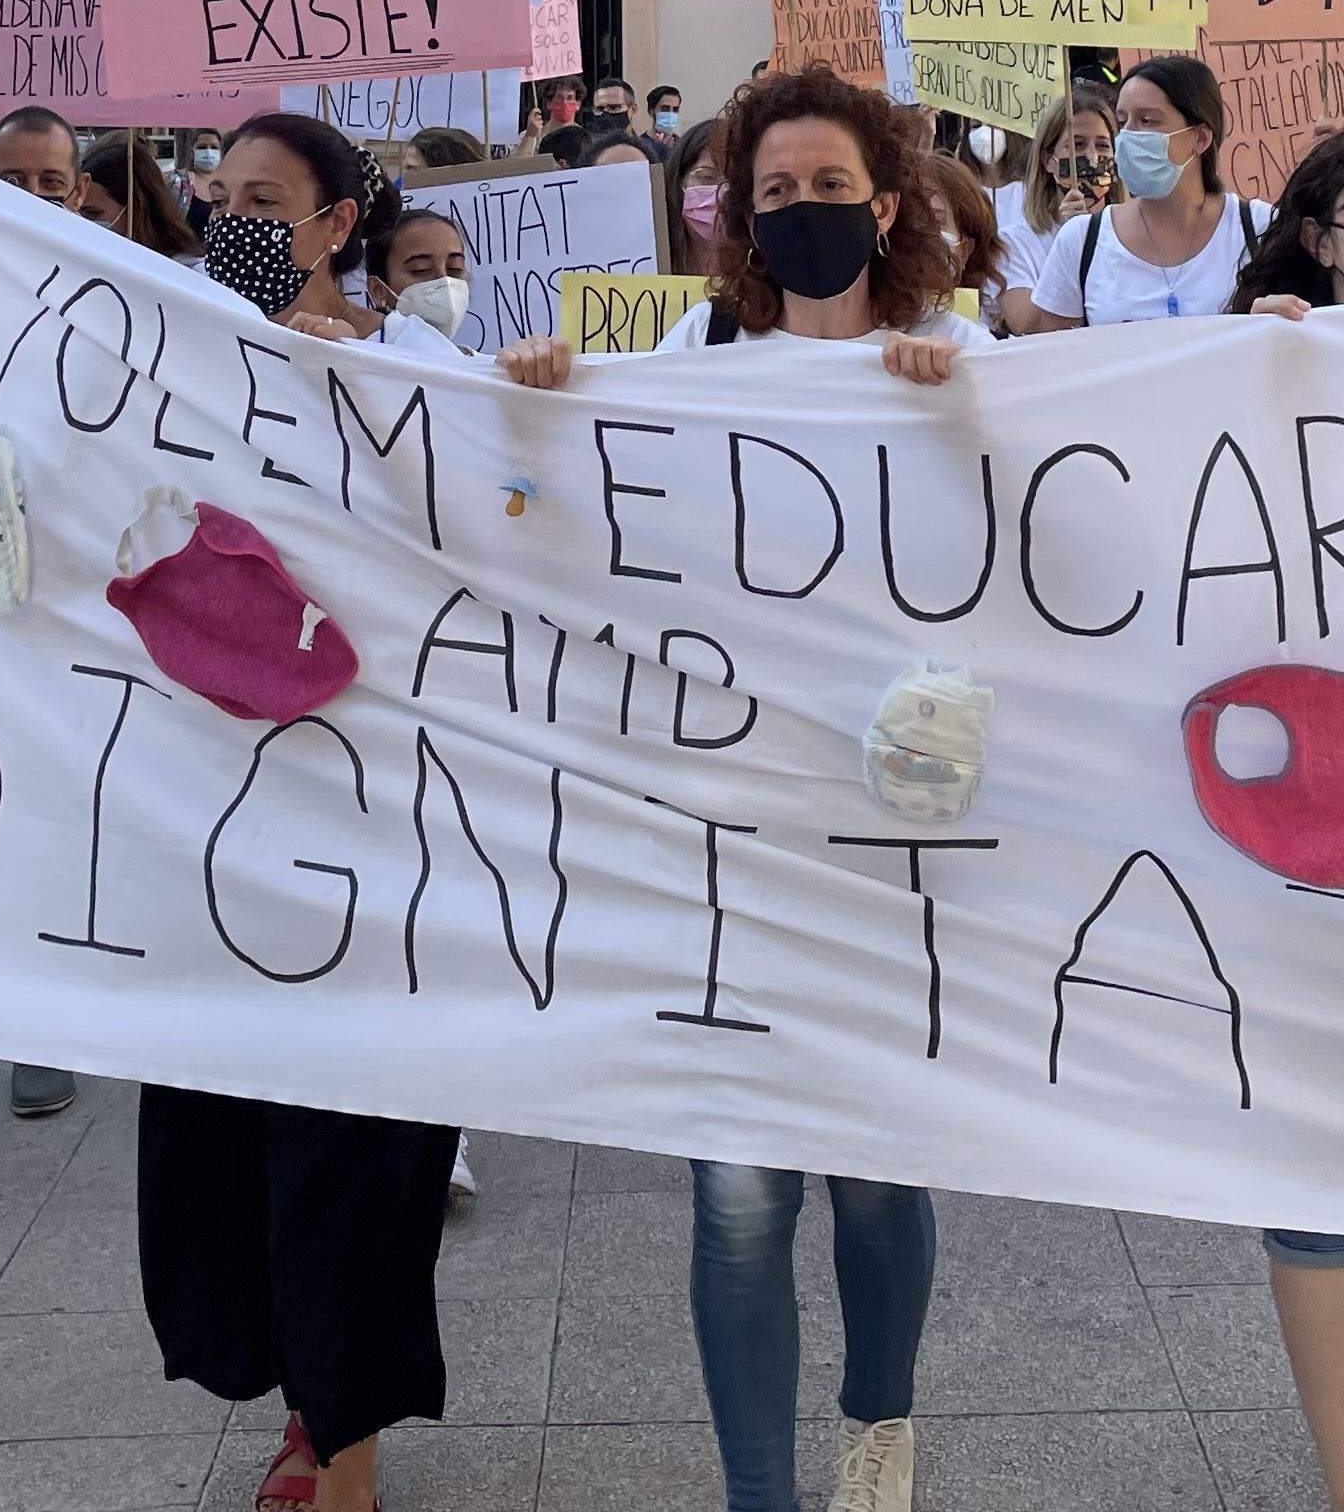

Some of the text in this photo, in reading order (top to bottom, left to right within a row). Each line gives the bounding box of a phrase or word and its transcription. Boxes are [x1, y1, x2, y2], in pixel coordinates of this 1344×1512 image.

[12, 34, 44, 97] DE
[49, 34, 89, 97] MIS
[533, 31, 570, 49] SOLO
[913, 53, 950, 98] SERAN
[954, 64, 977, 106] ELS
[411, 586, 758, 750] AMB
